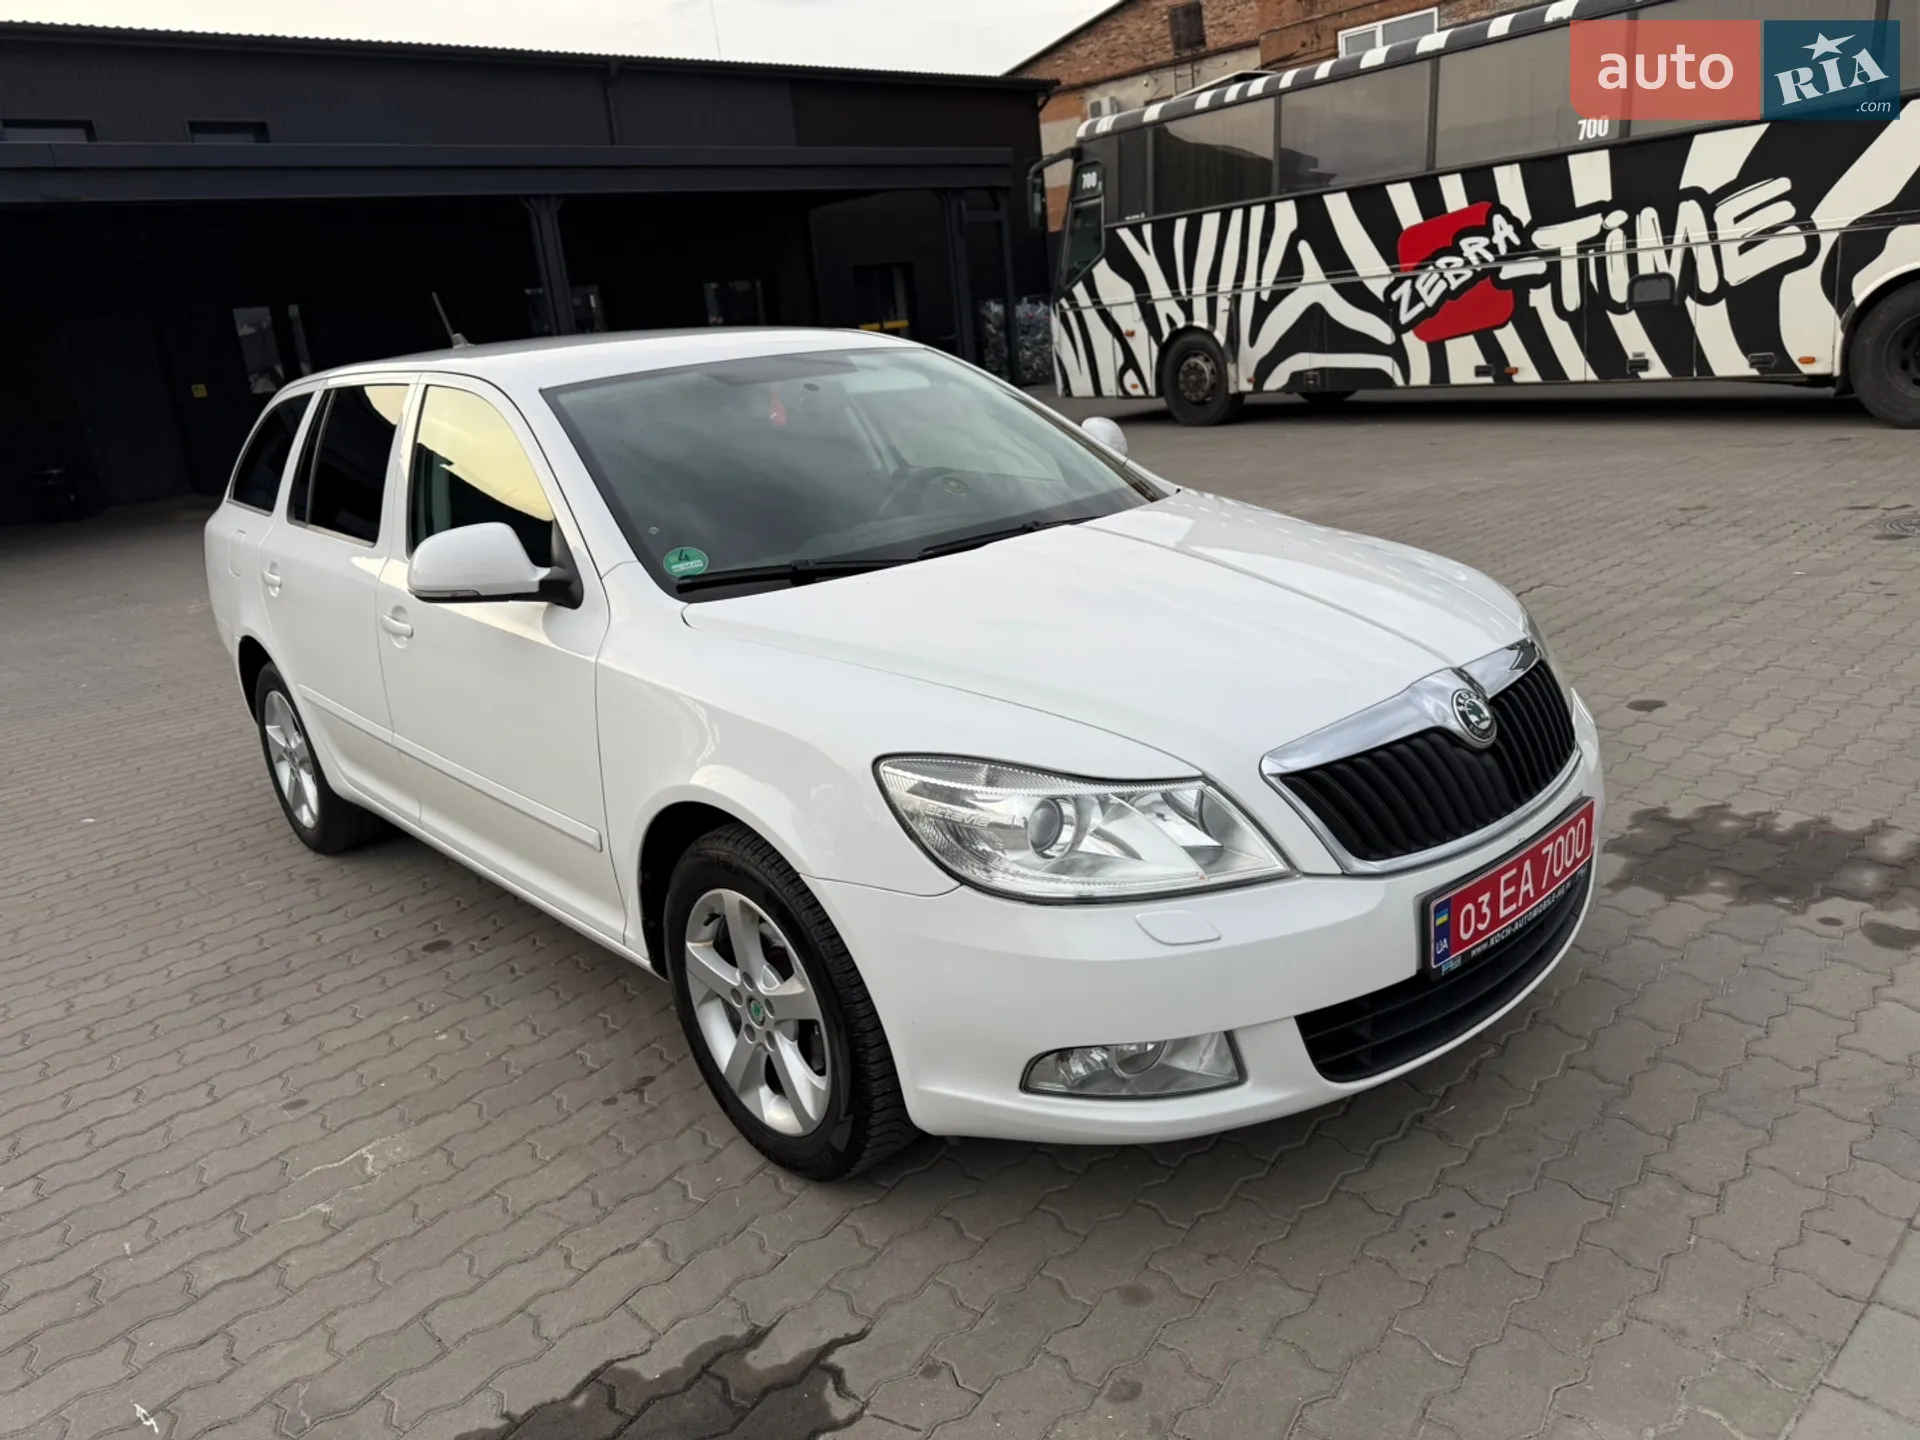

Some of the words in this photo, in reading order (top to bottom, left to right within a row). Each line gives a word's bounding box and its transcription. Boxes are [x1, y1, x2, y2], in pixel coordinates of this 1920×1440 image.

[1577, 116, 1610, 141] 700
[1391, 213, 1521, 326] ZEBRA
[1459, 891, 1491, 941] 03
[1499, 858, 1535, 919] EA
[1541, 817, 1587, 890] 7000
[1436, 937, 1449, 955] UA
